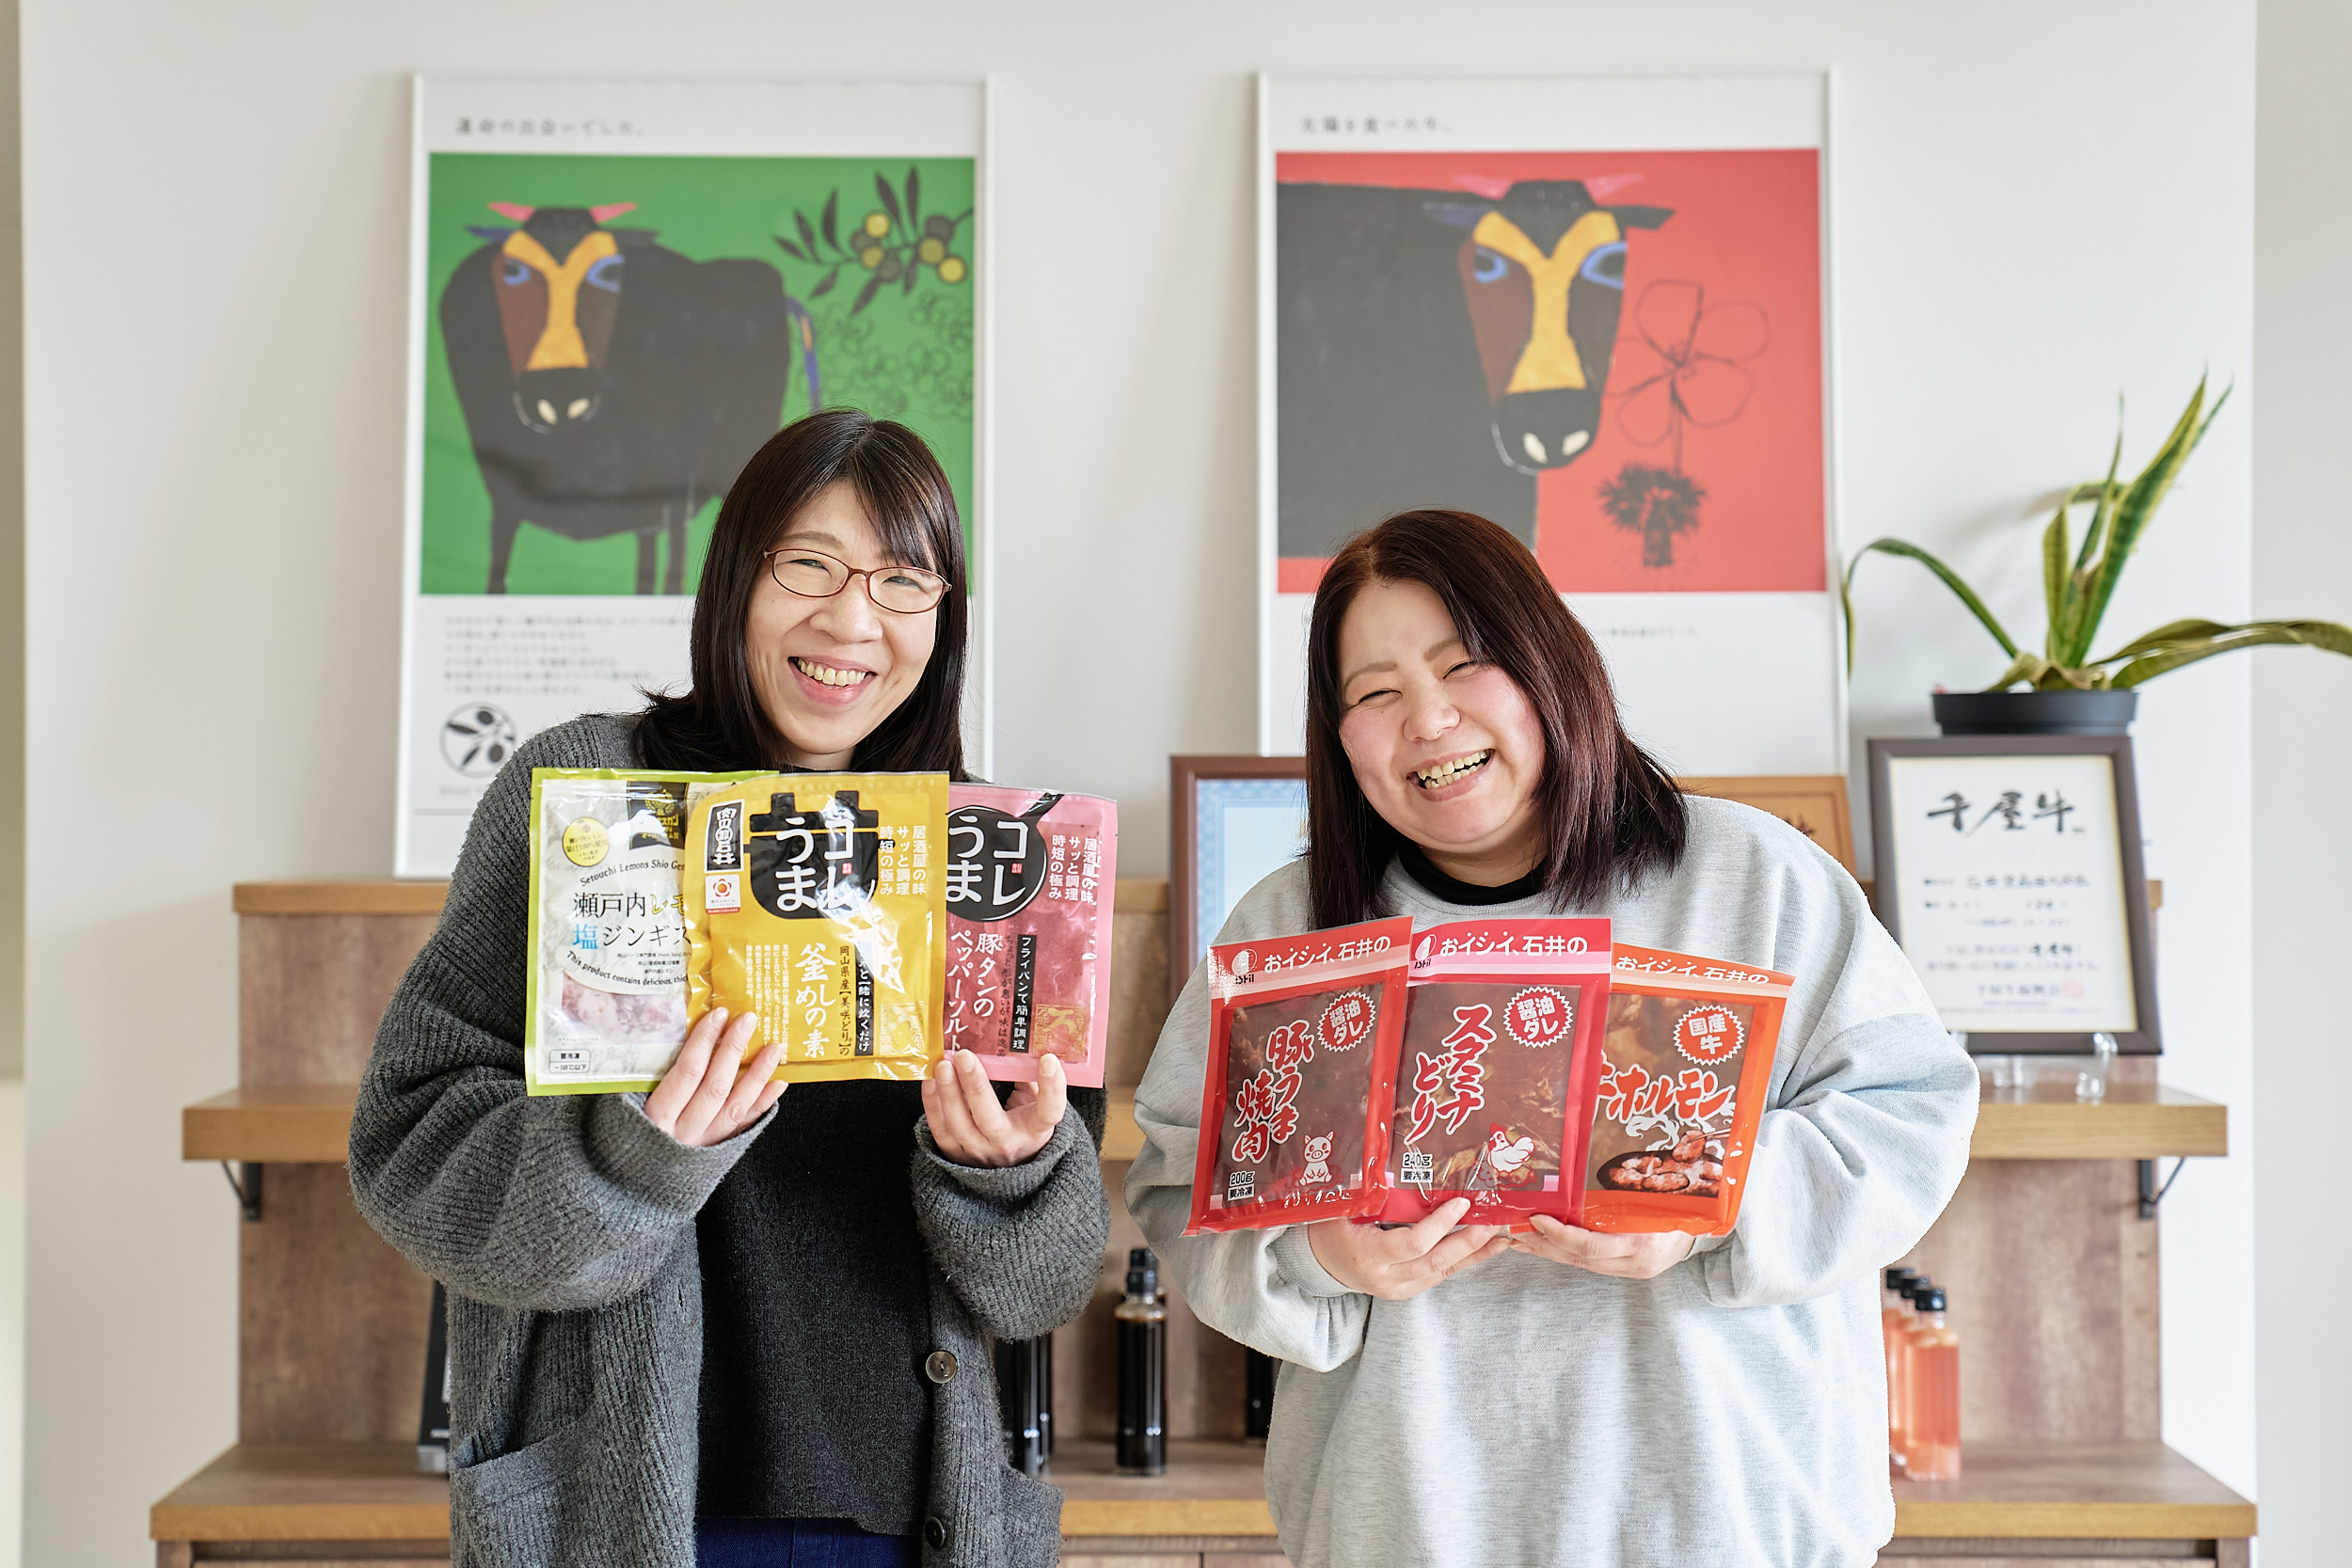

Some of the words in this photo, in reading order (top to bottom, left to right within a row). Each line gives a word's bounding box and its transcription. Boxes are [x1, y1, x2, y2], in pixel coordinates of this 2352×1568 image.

[580, 865, 617, 887] Setouchi
[620, 860, 649, 873] Lemons
[651, 859, 669, 869] Shio
[775, 816, 818, 912] うま
[879, 825, 895, 896] 時短の極み
[896, 826, 911, 895] サッと調理
[912, 825, 927, 895] 居酒屋の味
[946, 815, 985, 904] うま
[993, 820, 1029, 907] コレ
[1048, 834, 1067, 899] 時短の極み
[1064, 836, 1081, 901] サッと調理
[1081, 837, 1097, 905] 居酒屋の味
[566, 950, 582, 967] This
[581, 961, 612, 980] product
[612, 973, 641, 986] contains
[794, 942, 837, 1059] 釜めしの素
[944, 929, 974, 1056] ペッパーソルト
[973, 932, 1001, 1018] 豚タンの
[1329, 999, 1362, 1028] 醤油
[1333, 1020, 1364, 1045] ダレ
[1516, 995, 1555, 1021] 醤油
[1522, 1017, 1560, 1040] ダレ
[1688, 1013, 1727, 1036] 国産
[1435, 1003, 1498, 1136] スタミナ
[1699, 1035, 1724, 1056] 牛
[1232, 1068, 1276, 1164] 焼肉
[1403, 1051, 1454, 1147] どり
[1229, 1170, 1255, 1187] 200g
[1229, 1185, 1254, 1200] 要冷凍
[1402, 1169, 1432, 1182] 要冷凍
